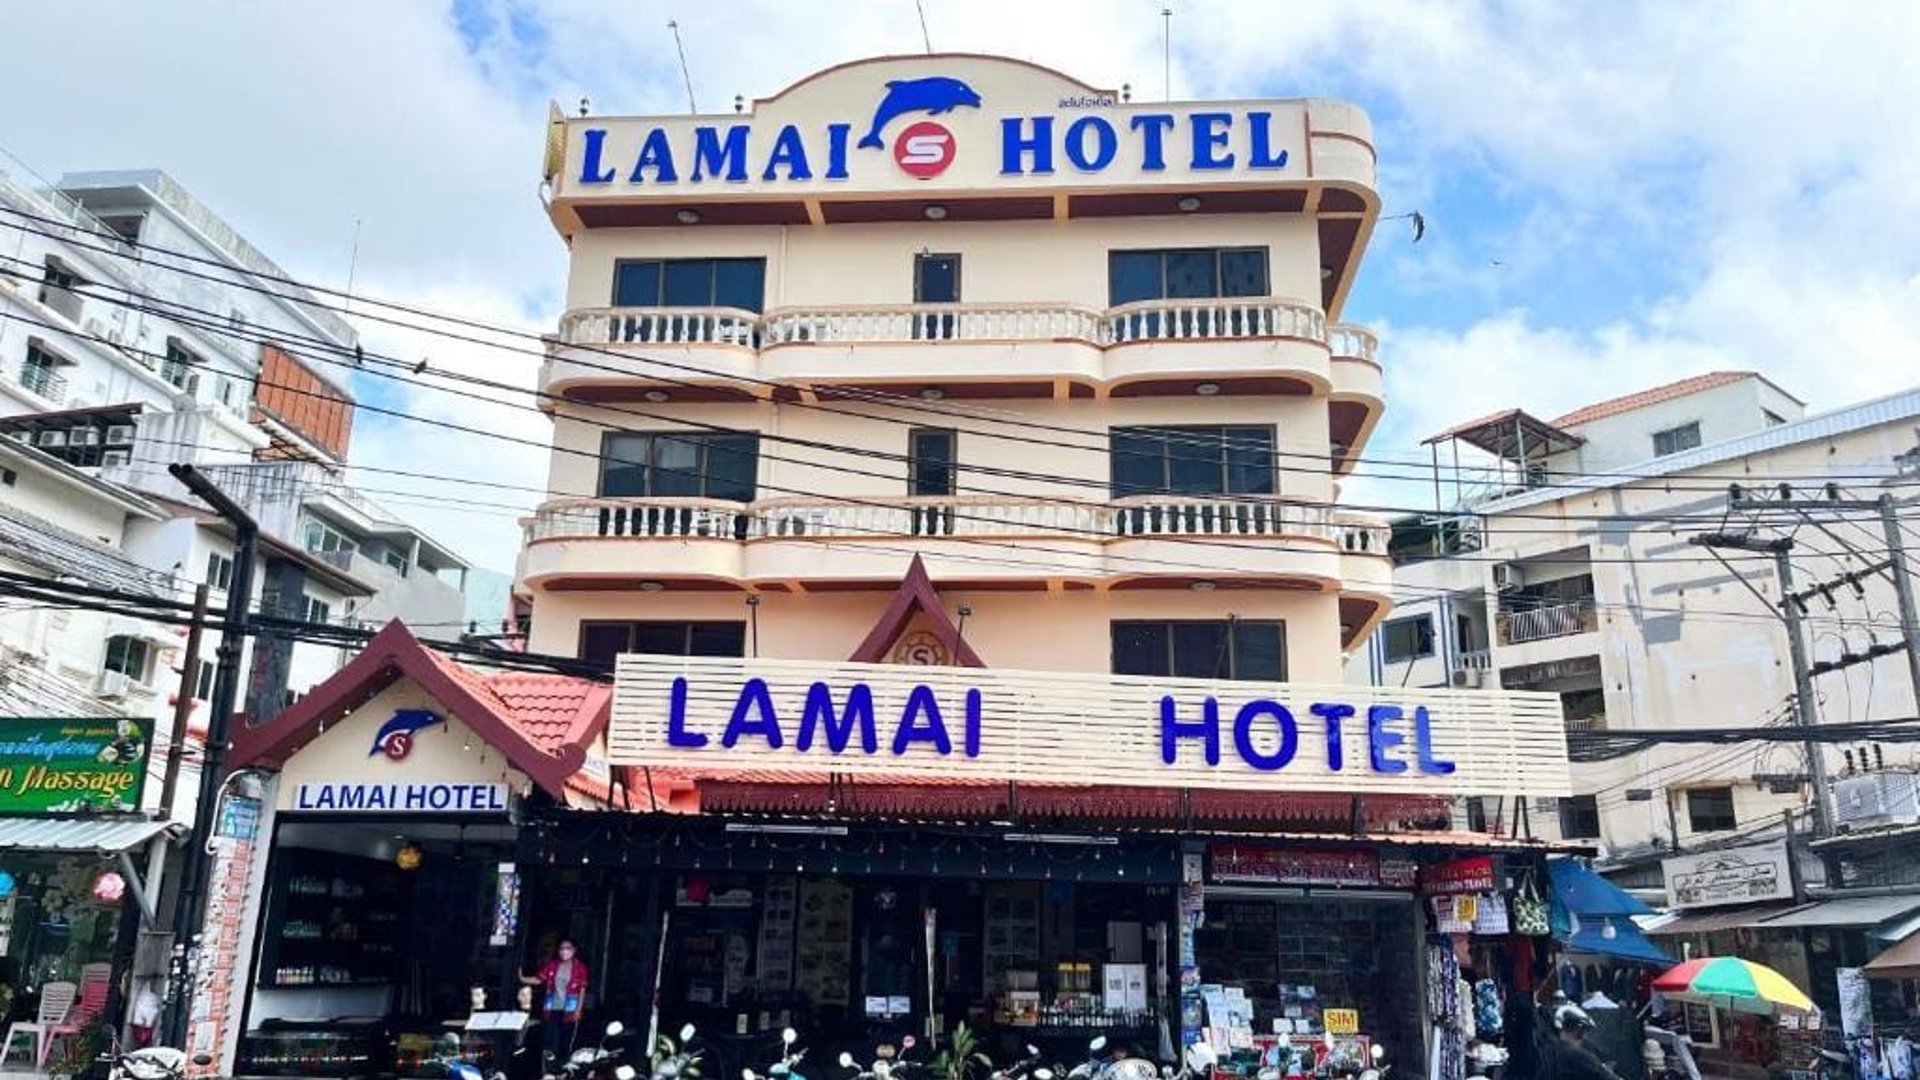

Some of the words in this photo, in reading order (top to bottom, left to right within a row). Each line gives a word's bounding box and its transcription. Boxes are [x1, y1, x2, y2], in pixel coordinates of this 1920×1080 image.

[579, 124, 851, 183] LAMAI
[1000, 112, 1288, 174] HOTEL
[901, 134, 949, 165] S
[913, 649, 929, 666] S
[667, 676, 982, 758] LAMAI
[1160, 695, 1456, 775] HOTEL
[392, 736, 405, 755] S
[15, 764, 134, 797] Massage
[299, 784, 397, 809] LAMAI
[405, 784, 504, 810] HOTEL
[1326, 1011, 1356, 1026] SIM
